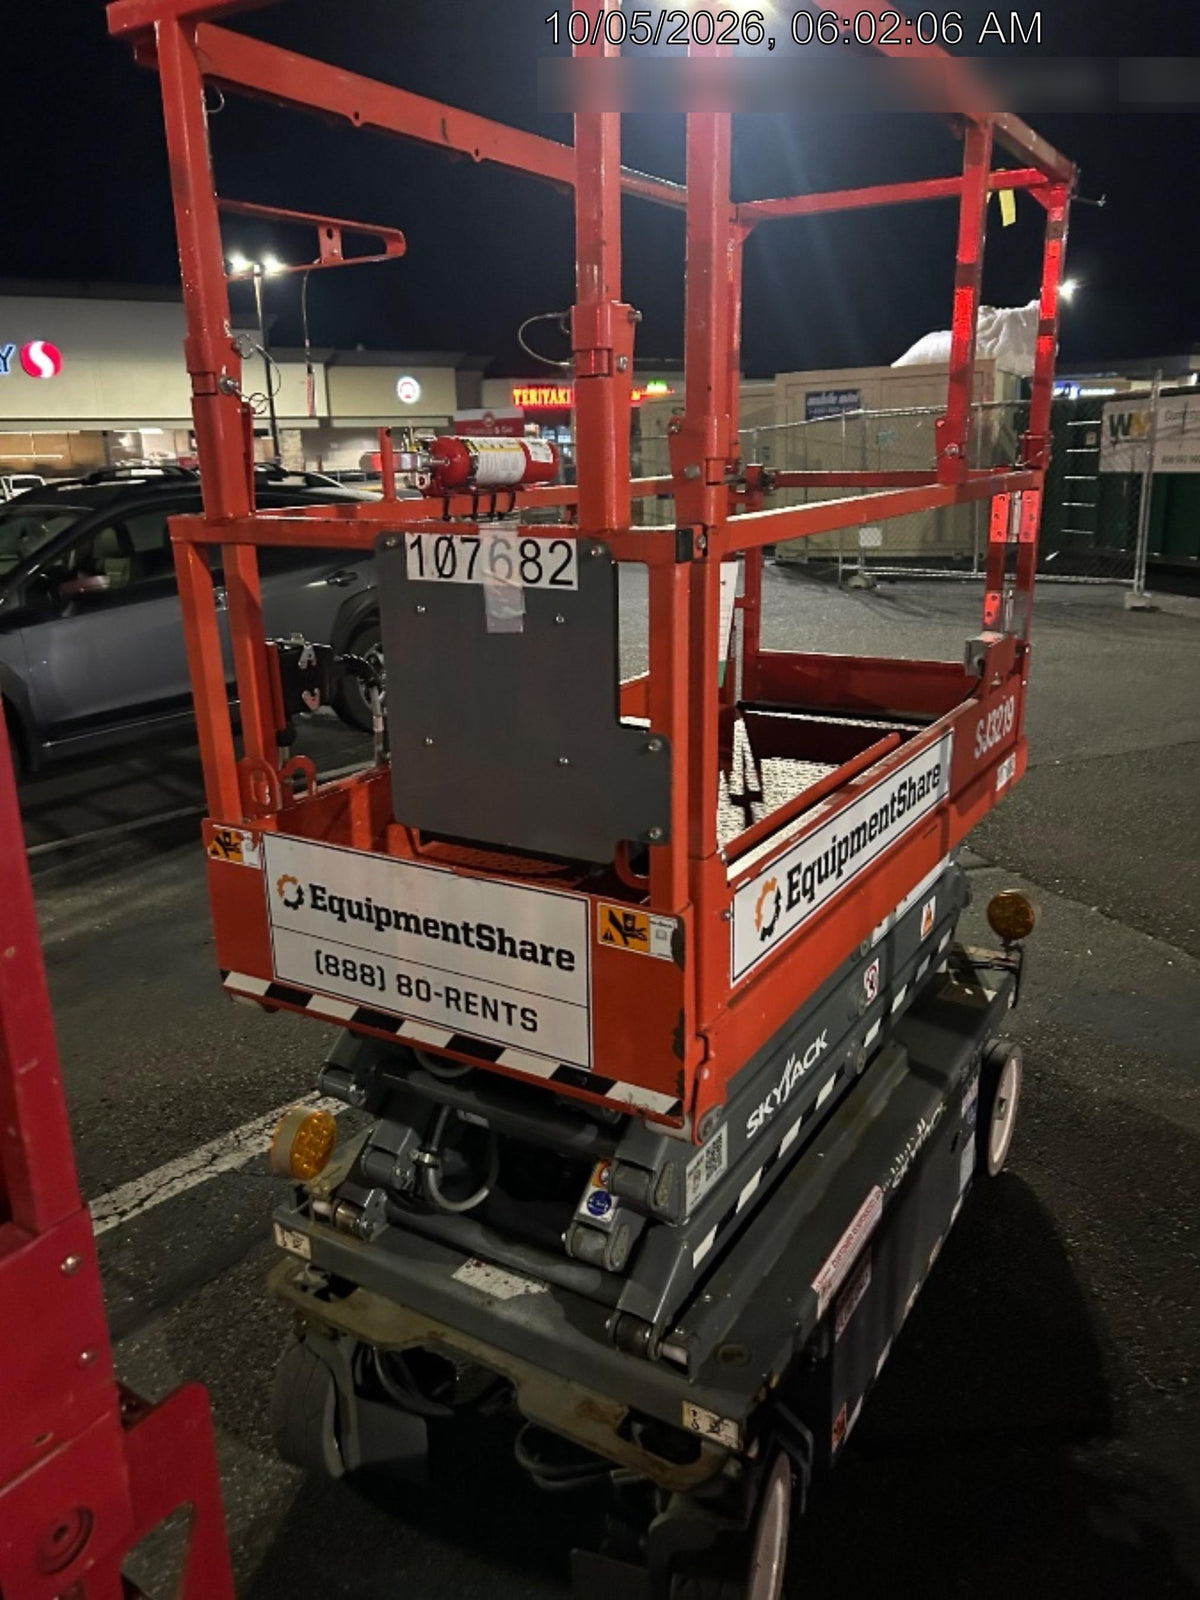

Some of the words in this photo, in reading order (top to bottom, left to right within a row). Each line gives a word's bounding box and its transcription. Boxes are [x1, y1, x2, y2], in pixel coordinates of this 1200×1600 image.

[512, 387, 571, 406] TERIYAKI
[409, 534, 574, 586] 107682
[786, 762, 942, 913] EquipmentShare
[309, 884, 576, 972] EquipmentShare
[315, 949, 387, 991] (888)
[396, 974, 538, 1033] 80-RENTS
[746, 1028, 829, 1139] SKYJACK
